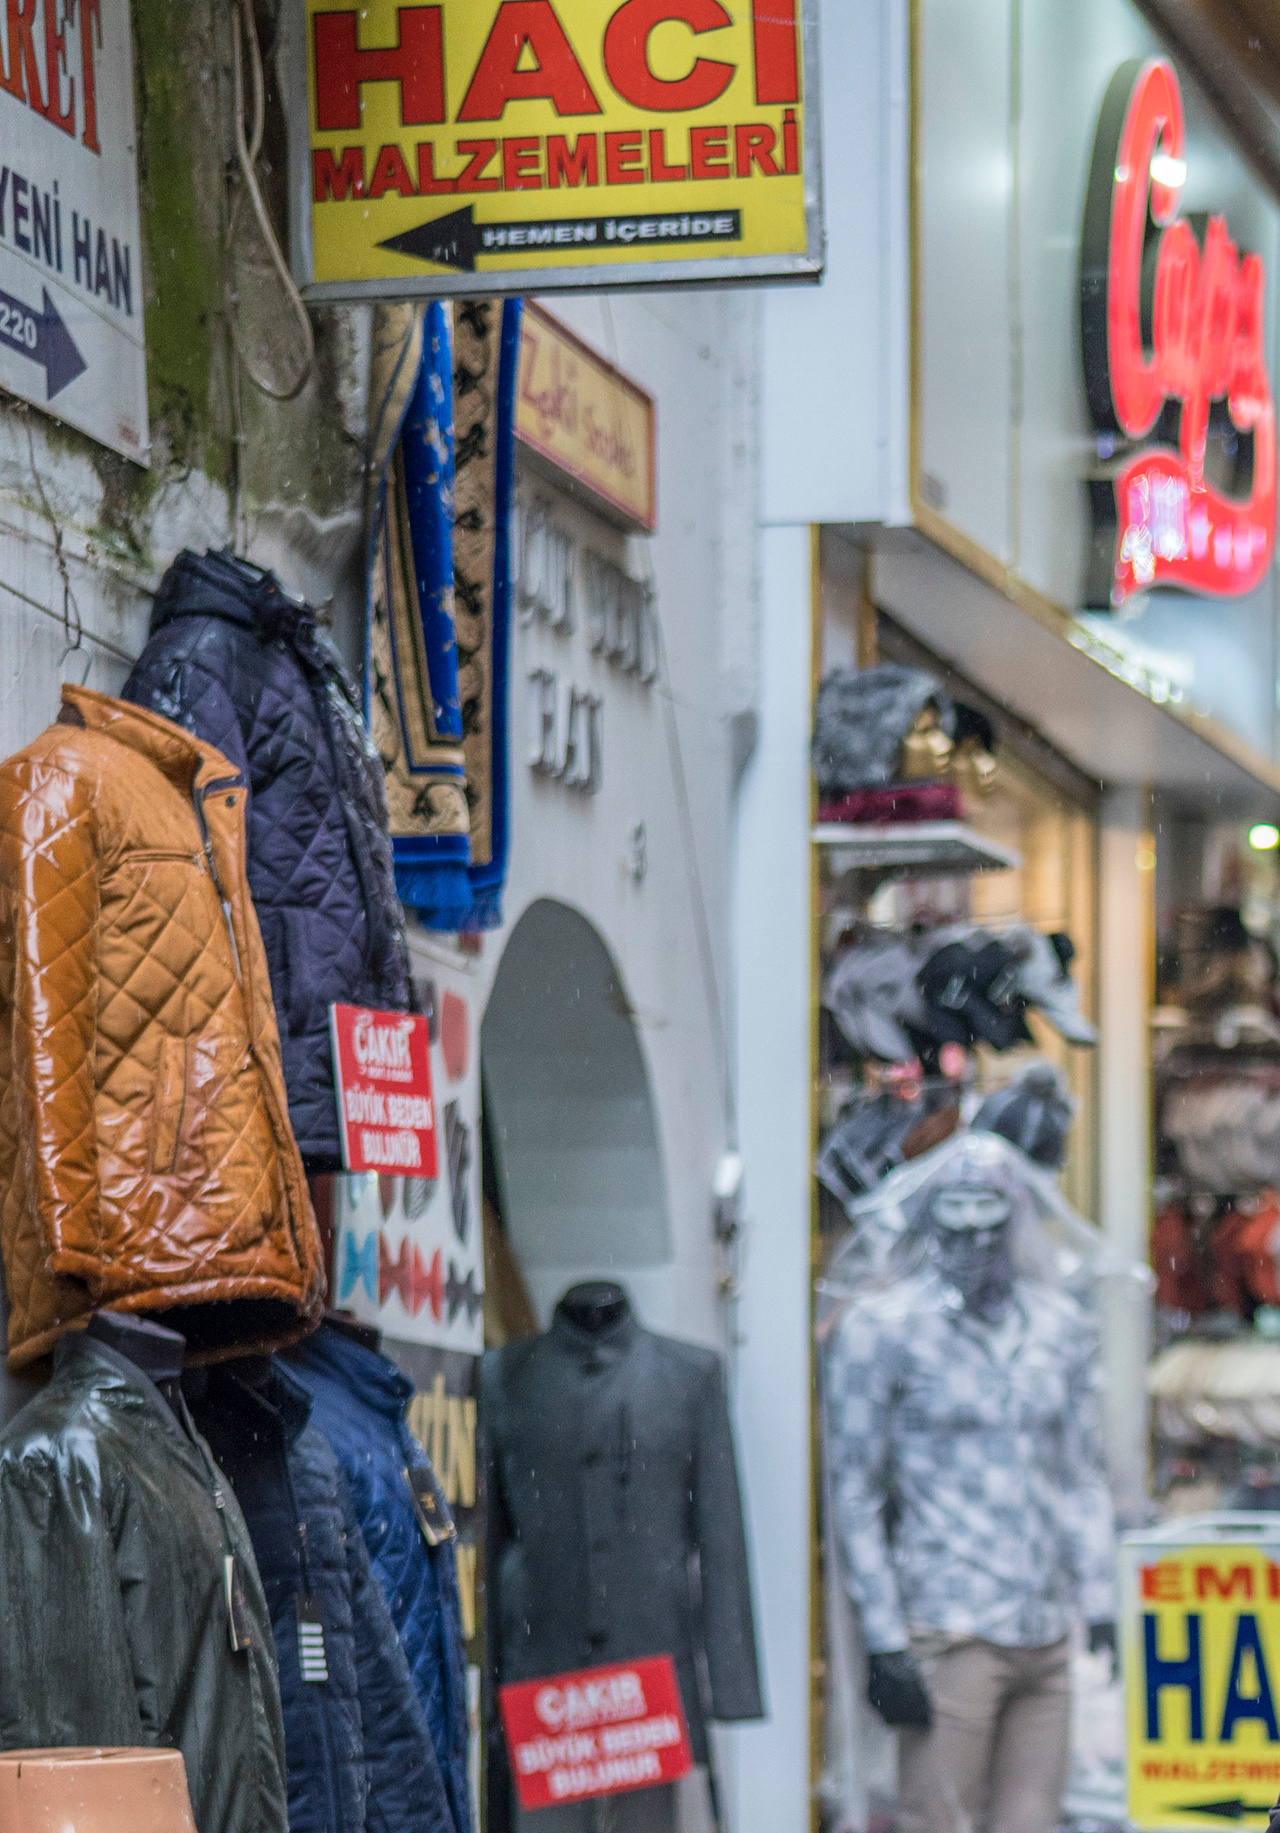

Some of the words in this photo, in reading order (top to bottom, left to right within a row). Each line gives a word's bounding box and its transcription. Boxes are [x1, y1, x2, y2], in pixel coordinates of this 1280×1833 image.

[0, 0, 101, 155] RET
[313, 0, 800, 131] HACI
[312, 108, 800, 203] MALZEMELERİ
[0, 165, 62, 273] YENİ
[72, 210, 133, 316] HAN
[483, 223, 597, 246] HEMEN
[604, 215, 734, 242] İÇERİDE
